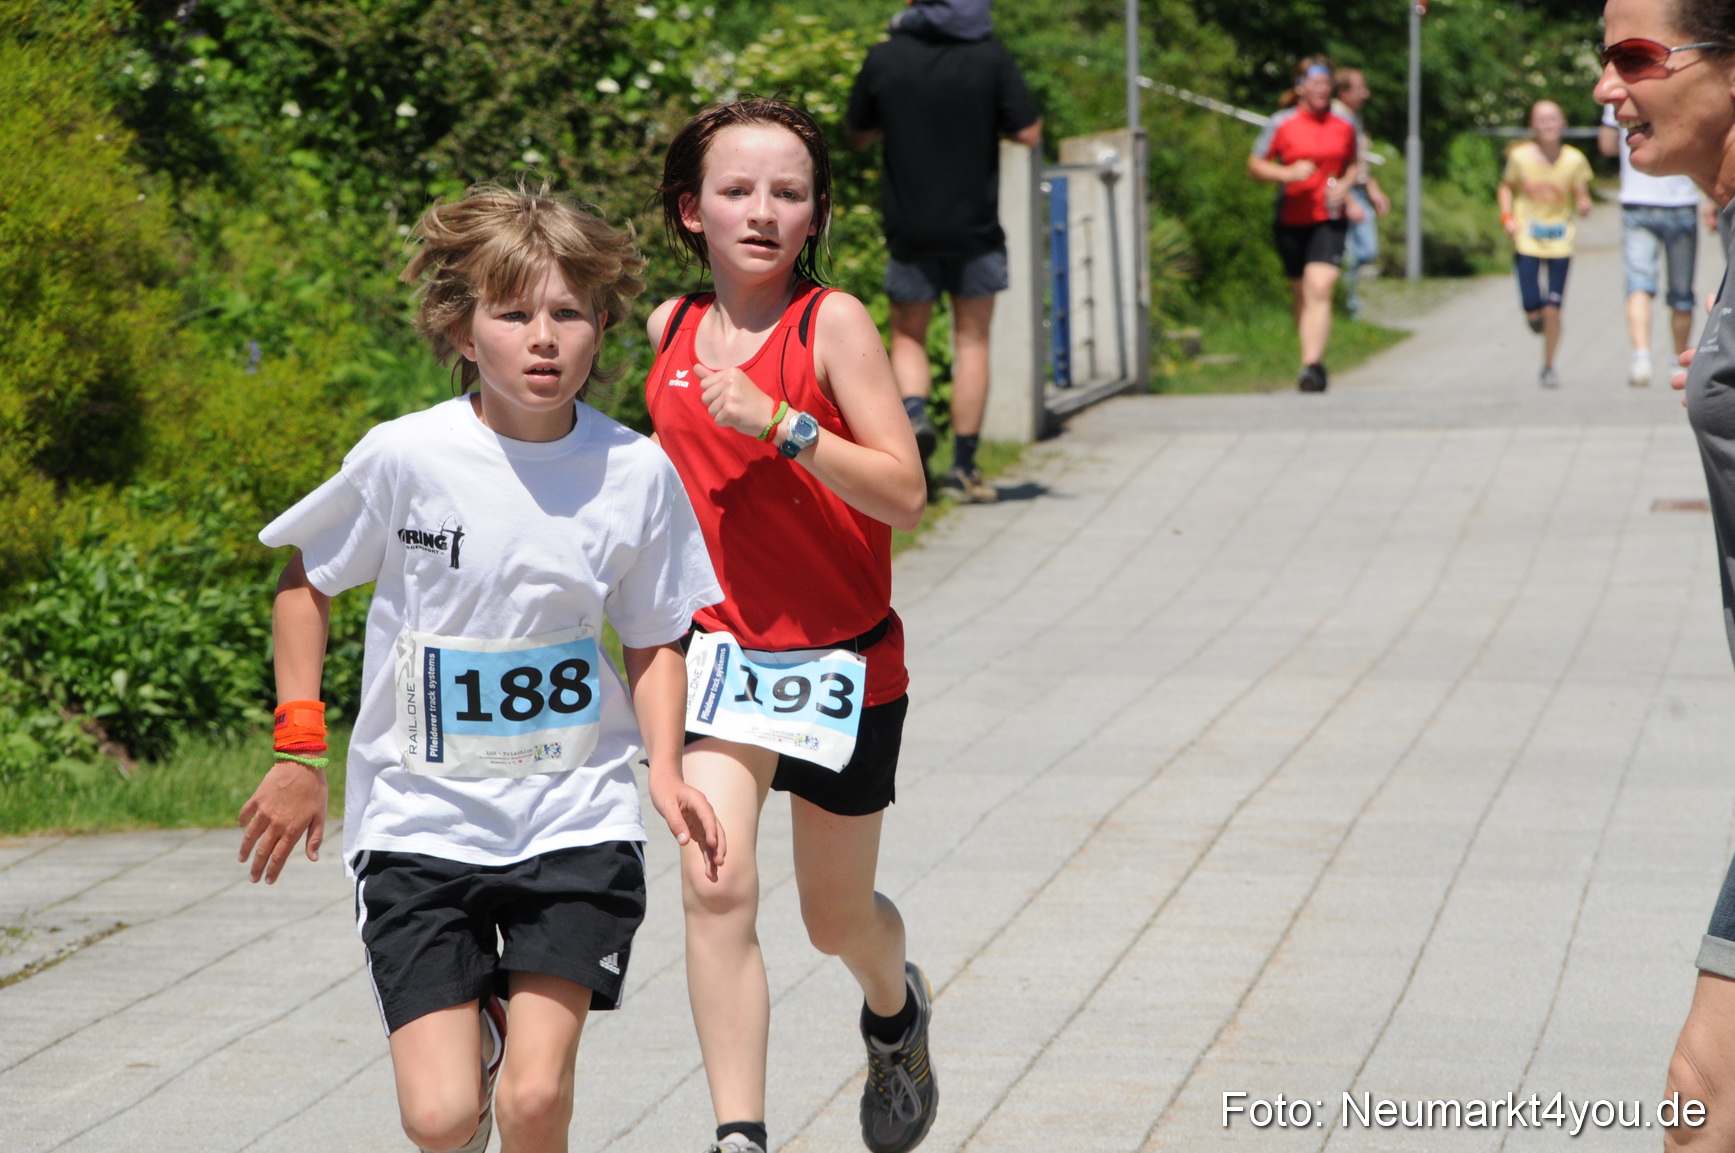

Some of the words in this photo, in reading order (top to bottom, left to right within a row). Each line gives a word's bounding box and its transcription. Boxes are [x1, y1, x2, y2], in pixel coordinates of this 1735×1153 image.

[428, 653, 436, 689] systems
[455, 658, 592, 722] 188
[711, 677, 721, 692] track
[716, 648, 726, 677] systems
[734, 664, 855, 720] 193
[406, 683, 418, 755] RAIL.ONE
[428, 690, 436, 711] track
[429, 713, 438, 757] Pfleiderer
